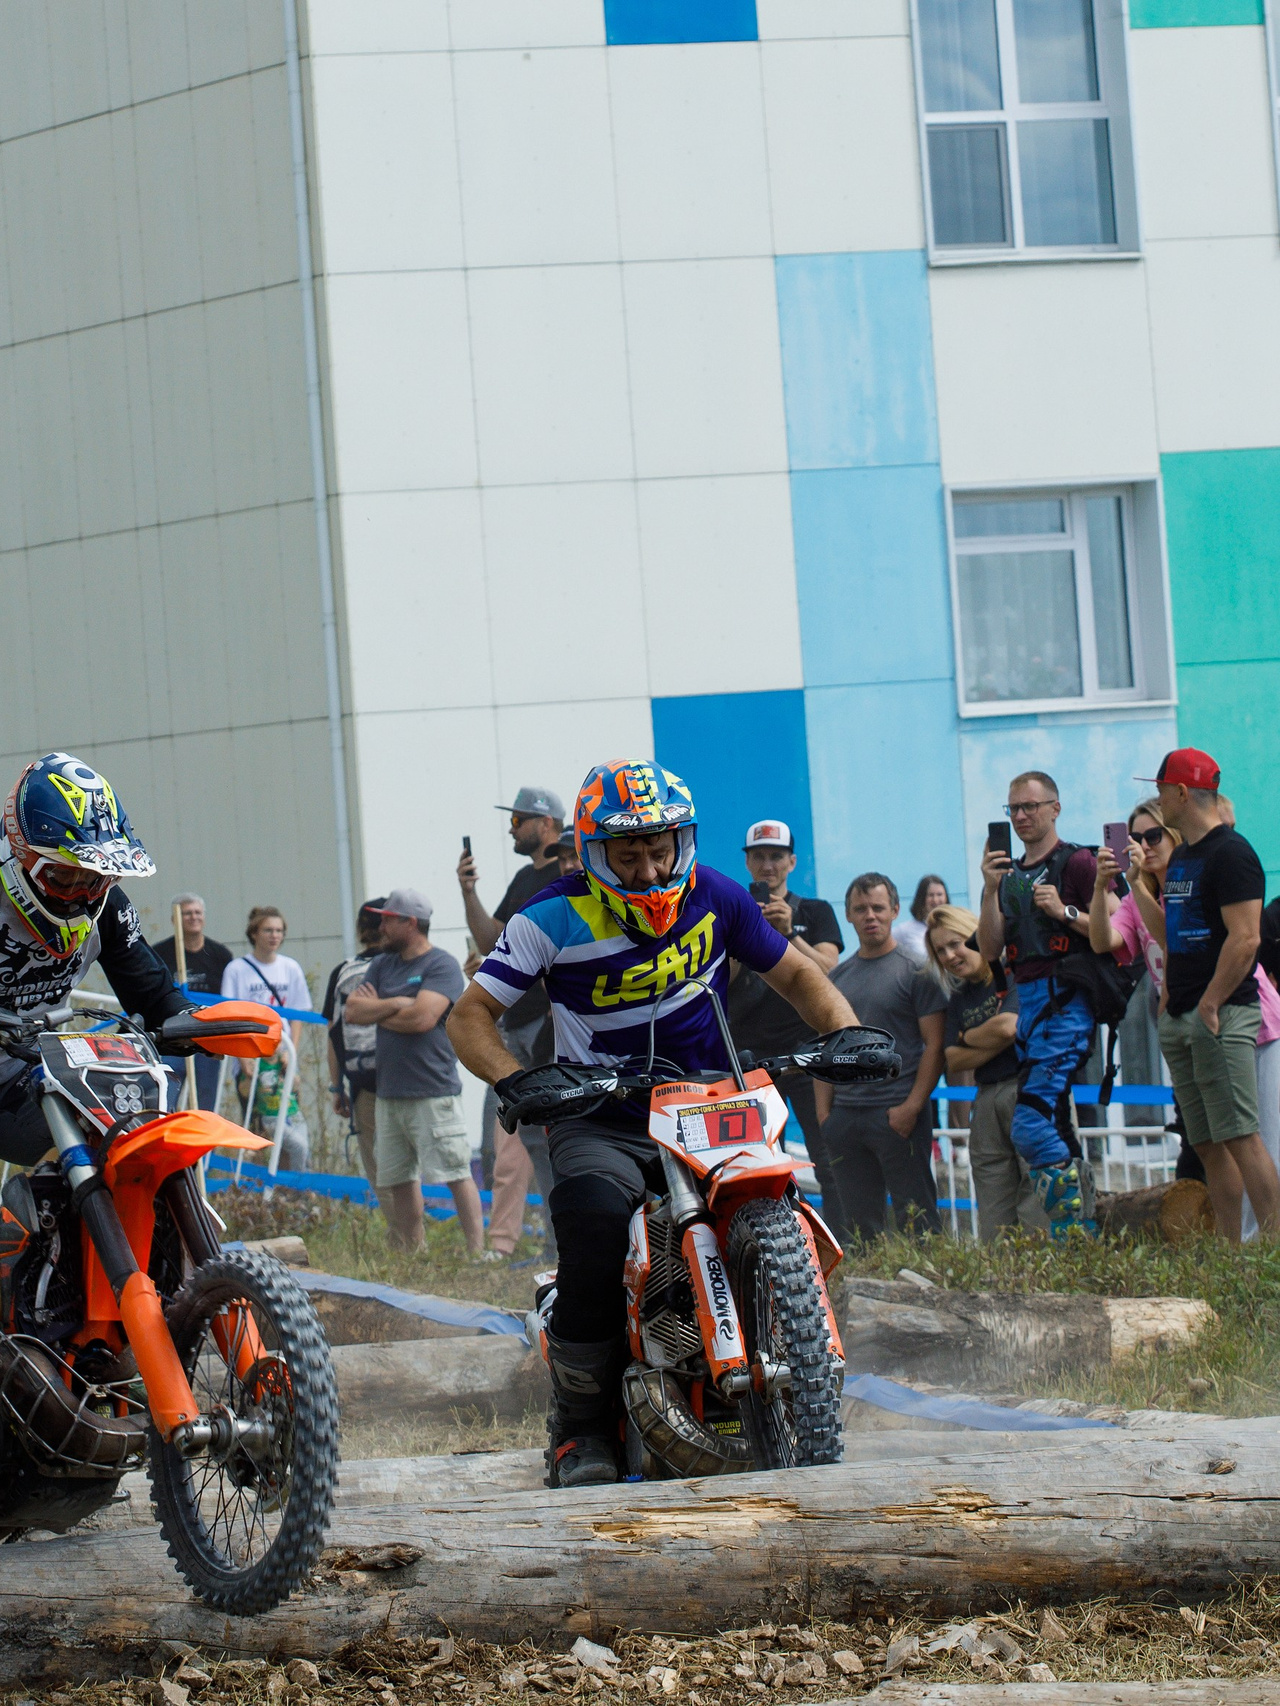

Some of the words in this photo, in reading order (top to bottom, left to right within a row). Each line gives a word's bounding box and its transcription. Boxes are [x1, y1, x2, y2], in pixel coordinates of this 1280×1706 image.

[604, 814, 639, 826] Airoh
[665, 805, 689, 821] Airoh
[636, 910, 651, 928] Airoh
[665, 903, 676, 924] Airoh
[833, 1055, 858, 1064] CYCRA
[561, 1087, 584, 1099] CYCRA
[655, 1085, 682, 1097] DUNIN
[684, 1085, 704, 1094] IGOR
[719, 1111, 746, 1142] 1
[705, 1255, 731, 1318] MOTOREX
[713, 1421, 741, 1429] NDURO
